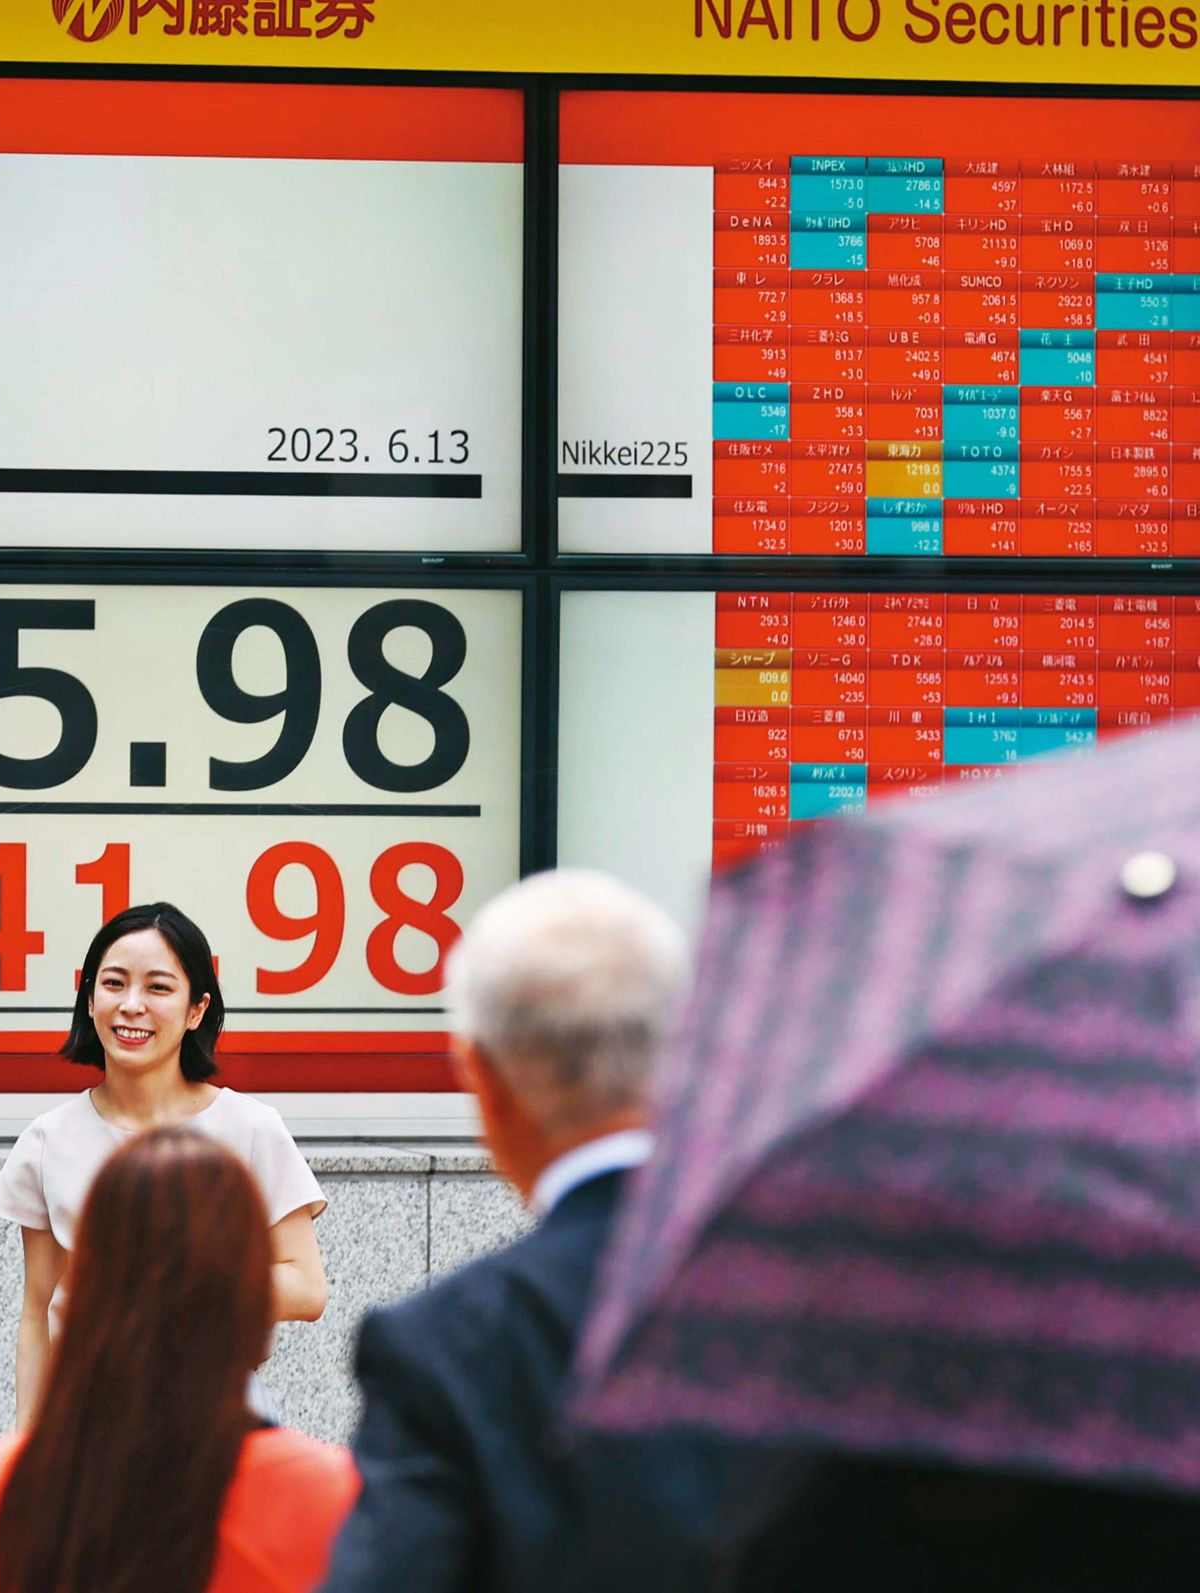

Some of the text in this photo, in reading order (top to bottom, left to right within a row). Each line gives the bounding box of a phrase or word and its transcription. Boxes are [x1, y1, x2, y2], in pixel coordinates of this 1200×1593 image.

[693, 0, 1199, 50] NAITO Securities
[811, 159, 845, 172] INPEX
[960, 275, 1002, 288] SUMCO
[561, 439, 689, 467] Nikkei225
